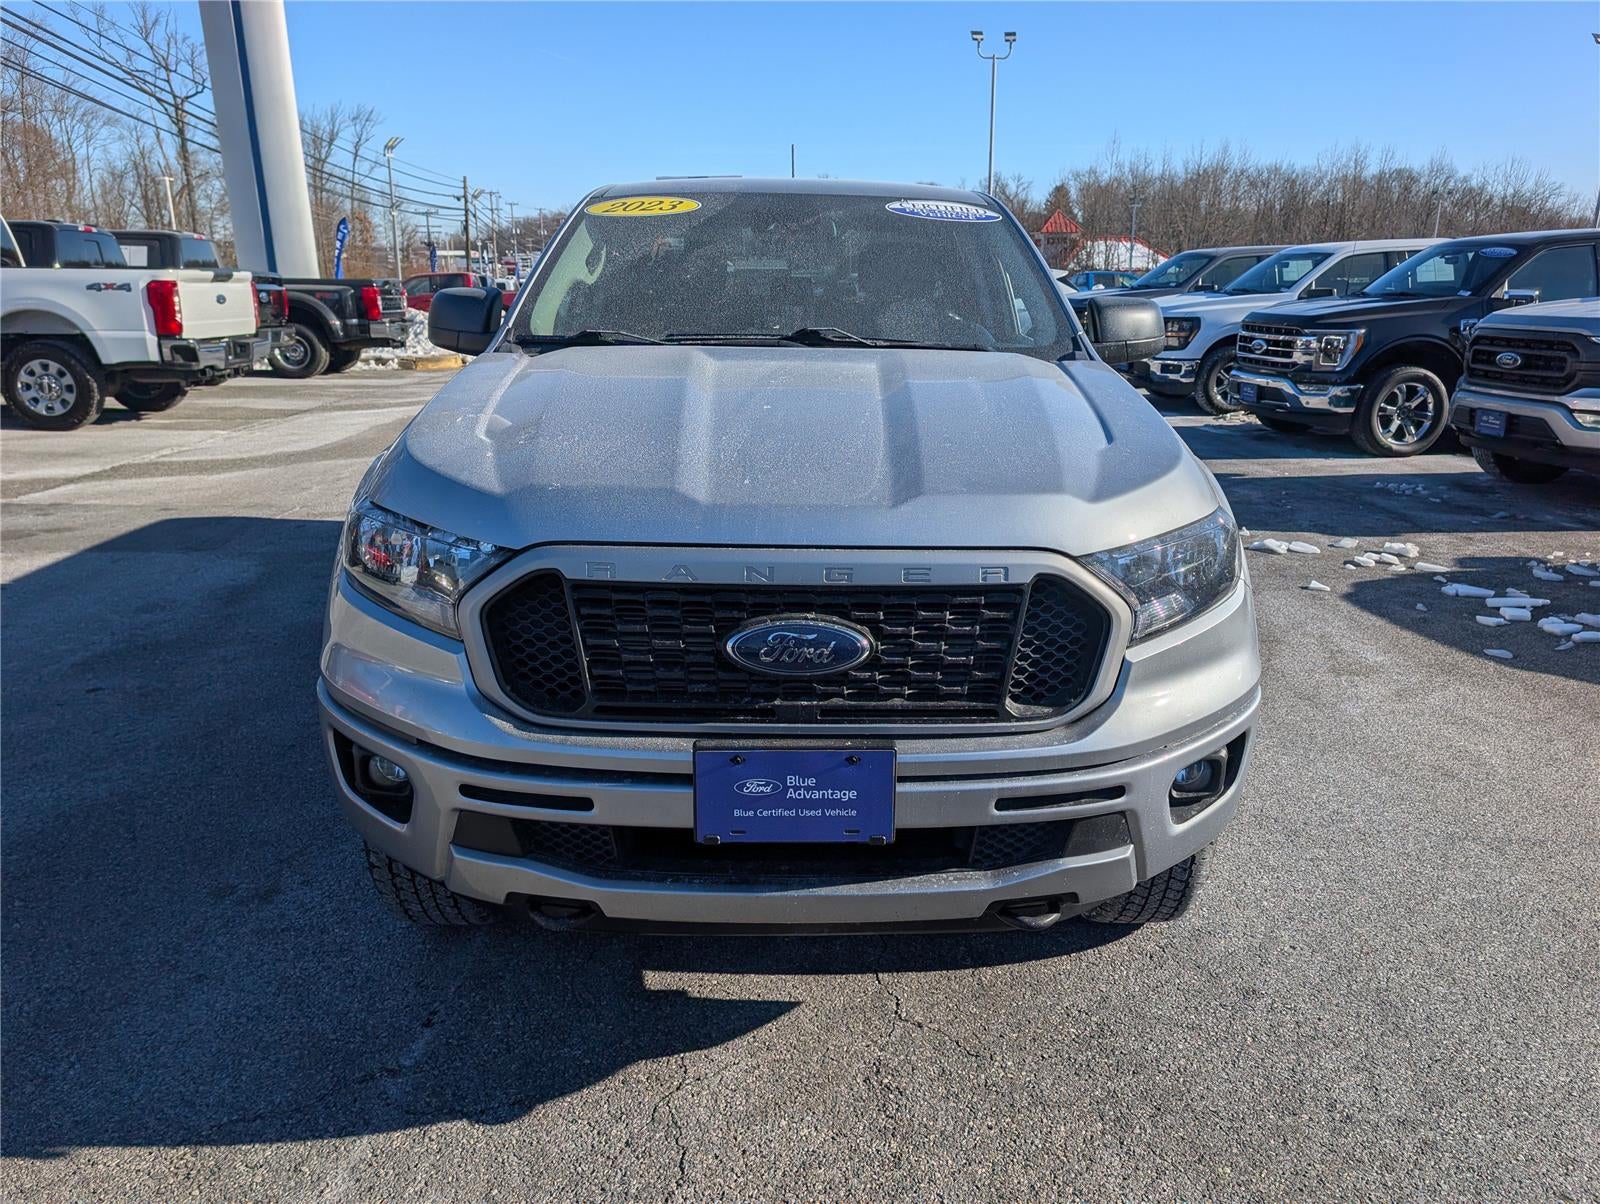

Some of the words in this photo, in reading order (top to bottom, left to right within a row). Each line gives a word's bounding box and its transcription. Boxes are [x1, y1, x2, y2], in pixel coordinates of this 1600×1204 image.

[602, 200, 684, 213] 2023
[899, 202, 988, 215] CERTIFIED
[585, 561, 1010, 584] RANGER
[760, 631, 836, 663] Ford
[743, 780, 773, 794] Ford
[786, 775, 816, 787] Blue
[786, 788, 858, 802] Advantage
[733, 808, 754, 817] Blue
[757, 808, 796, 817] Certified
[798, 808, 822, 817] Used
[824, 808, 857, 817] Vehicle
